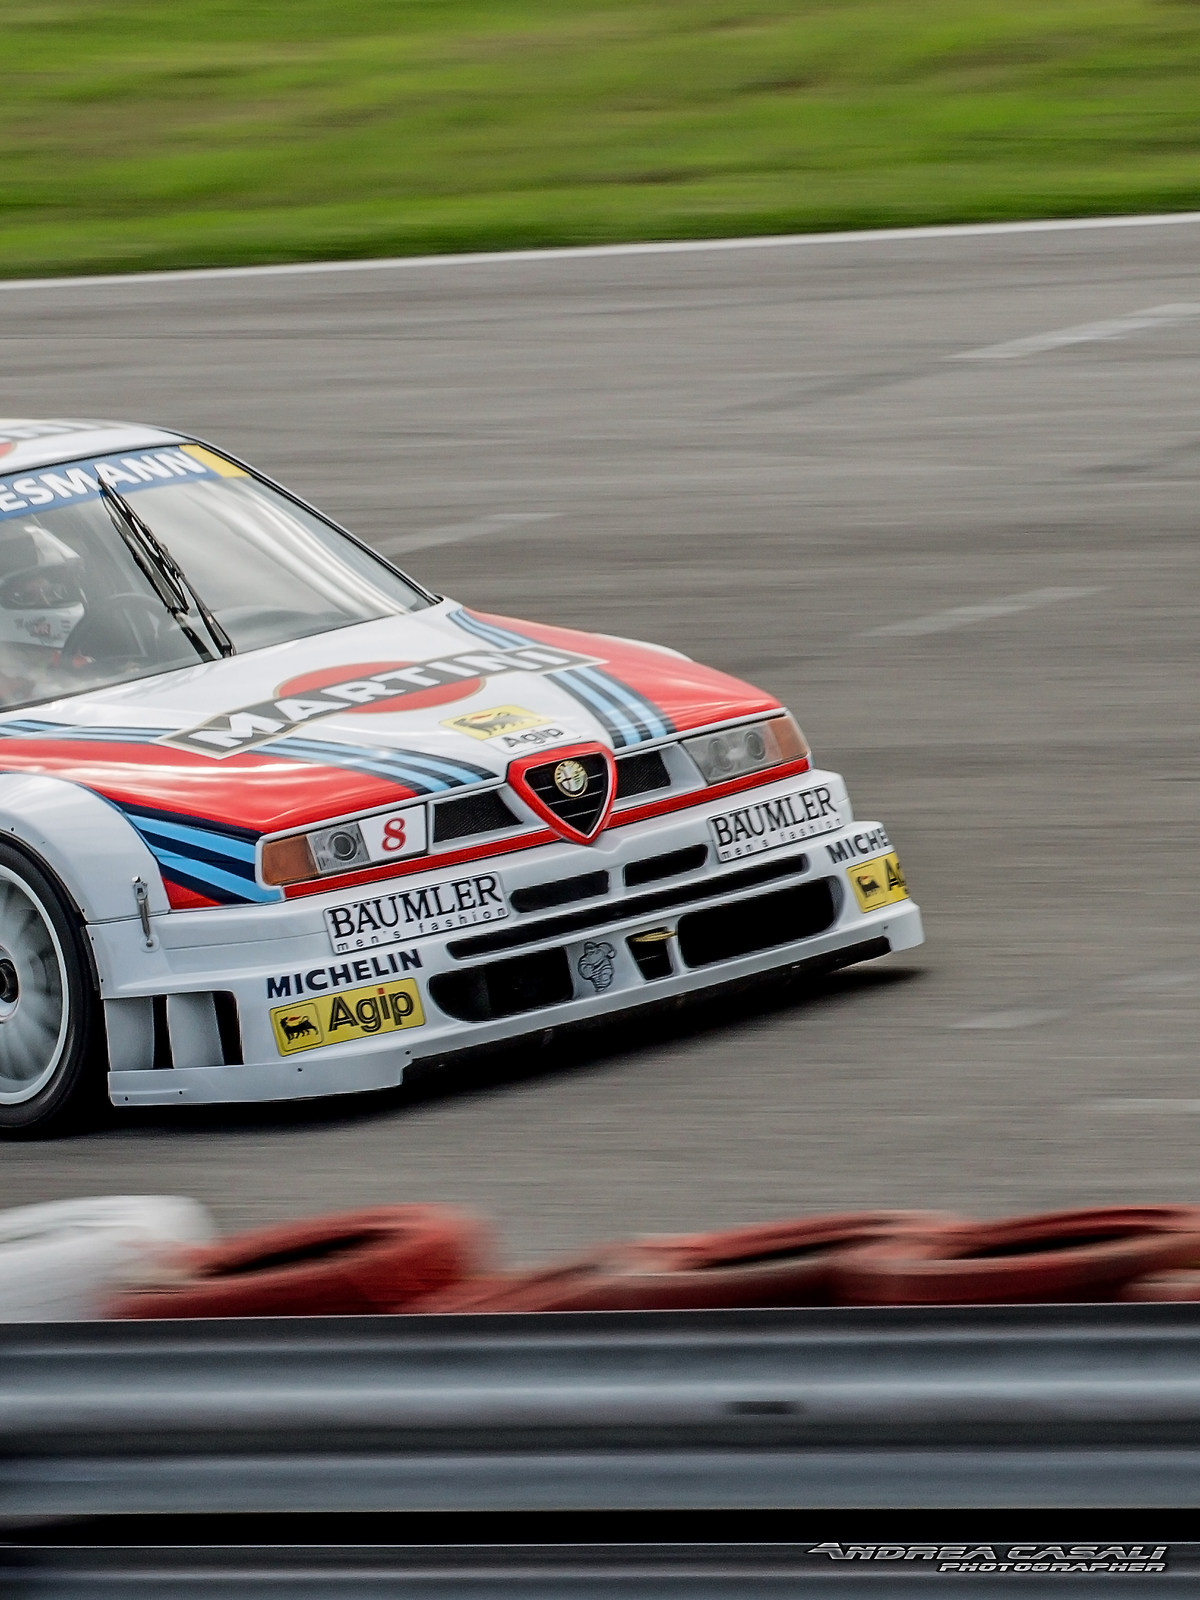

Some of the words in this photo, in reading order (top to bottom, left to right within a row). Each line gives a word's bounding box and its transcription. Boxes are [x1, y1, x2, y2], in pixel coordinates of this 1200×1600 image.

[188, 649, 571, 748] MARTINI
[502, 725, 565, 749] Agip
[381, 816, 407, 852] 8
[711, 786, 838, 847] BÄUMLER
[328, 875, 503, 939] BÄUMLER
[336, 928, 402, 953] men's
[418, 907, 507, 934] fashion
[267, 948, 424, 1000] MICHELIN
[328, 987, 414, 1033] Agip
